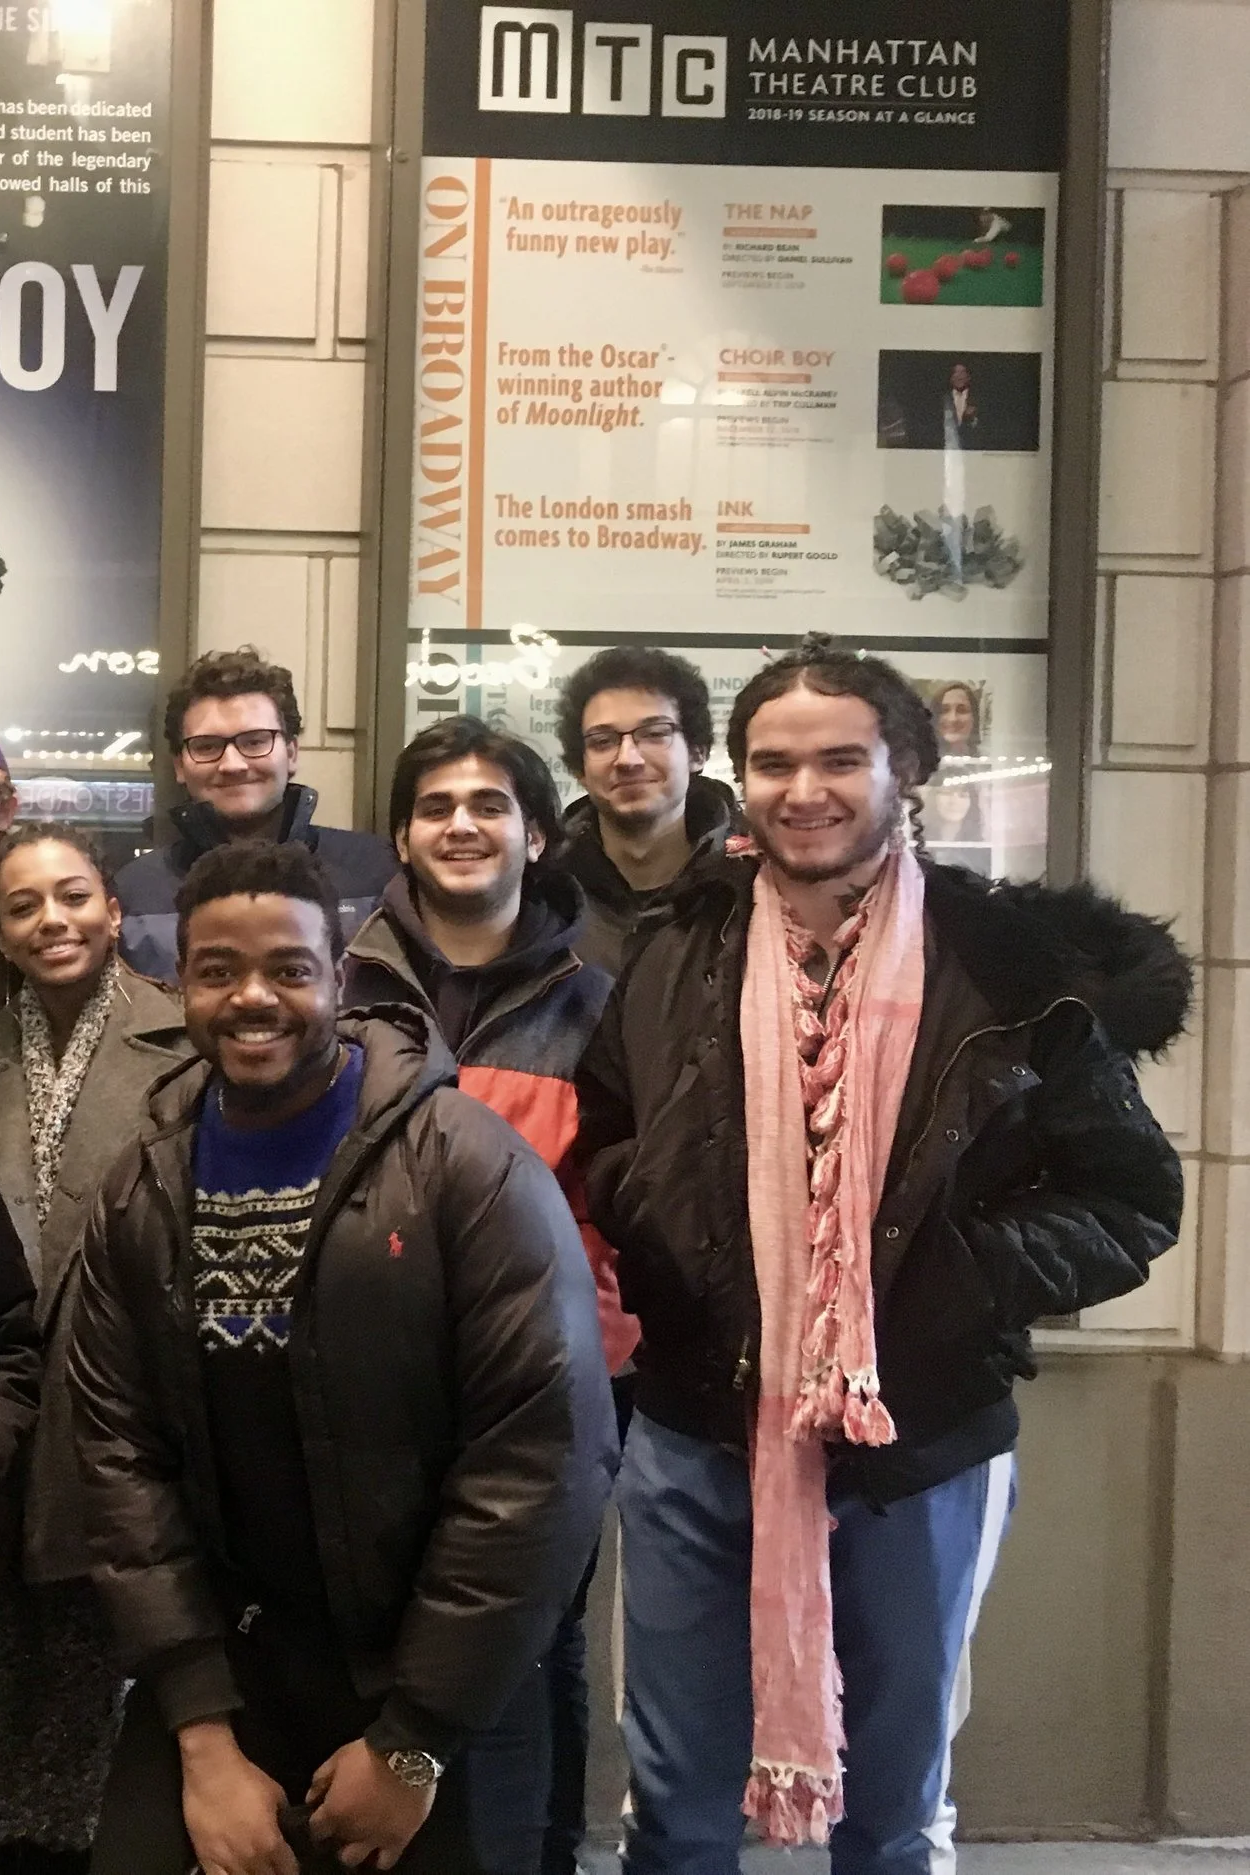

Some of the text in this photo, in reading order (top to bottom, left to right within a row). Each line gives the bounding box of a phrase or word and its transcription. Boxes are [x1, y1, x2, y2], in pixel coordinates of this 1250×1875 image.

[492, 21, 715, 105] MTC
[748, 37, 978, 66] MANHATTAN
[748, 71, 978, 99] THEATRE CLUB
[28, 100, 67, 116] been
[70, 101, 152, 117] dedicated
[748, 107, 976, 125] 2018-19 SEASON AT A GLANCE
[10, 125, 73, 141] student
[78, 126, 106, 142] has
[111, 127, 151, 143] been
[12, 150, 29, 166] of
[37, 151, 63, 166] the
[72, 151, 151, 171] legendary
[49, 176, 89, 193] halls
[96, 178, 112, 193] of
[120, 178, 151, 194] this
[541, 199, 682, 230] outrageously
[724, 203, 814, 221] THE NAP
[506, 227, 568, 258] funny
[575, 235, 620, 254] new
[735, 243, 775, 251] RICHARD
[498, 341, 551, 367] From
[558, 343, 593, 368] the
[719, 348, 836, 367] CHOIR BOY
[416, 175, 469, 606] ON BROADWAY
[497, 372, 662, 403] winning author
[497, 400, 645, 433] of Moonlight.
[494, 493, 692, 521] The London smash
[717, 500, 754, 517] INK
[494, 528, 561, 548] comes
[567, 526, 590, 548] to
[597, 524, 707, 557] Broadway.
[729, 540, 756, 548] JAMES
[805, 552, 838, 560] GOOLD
